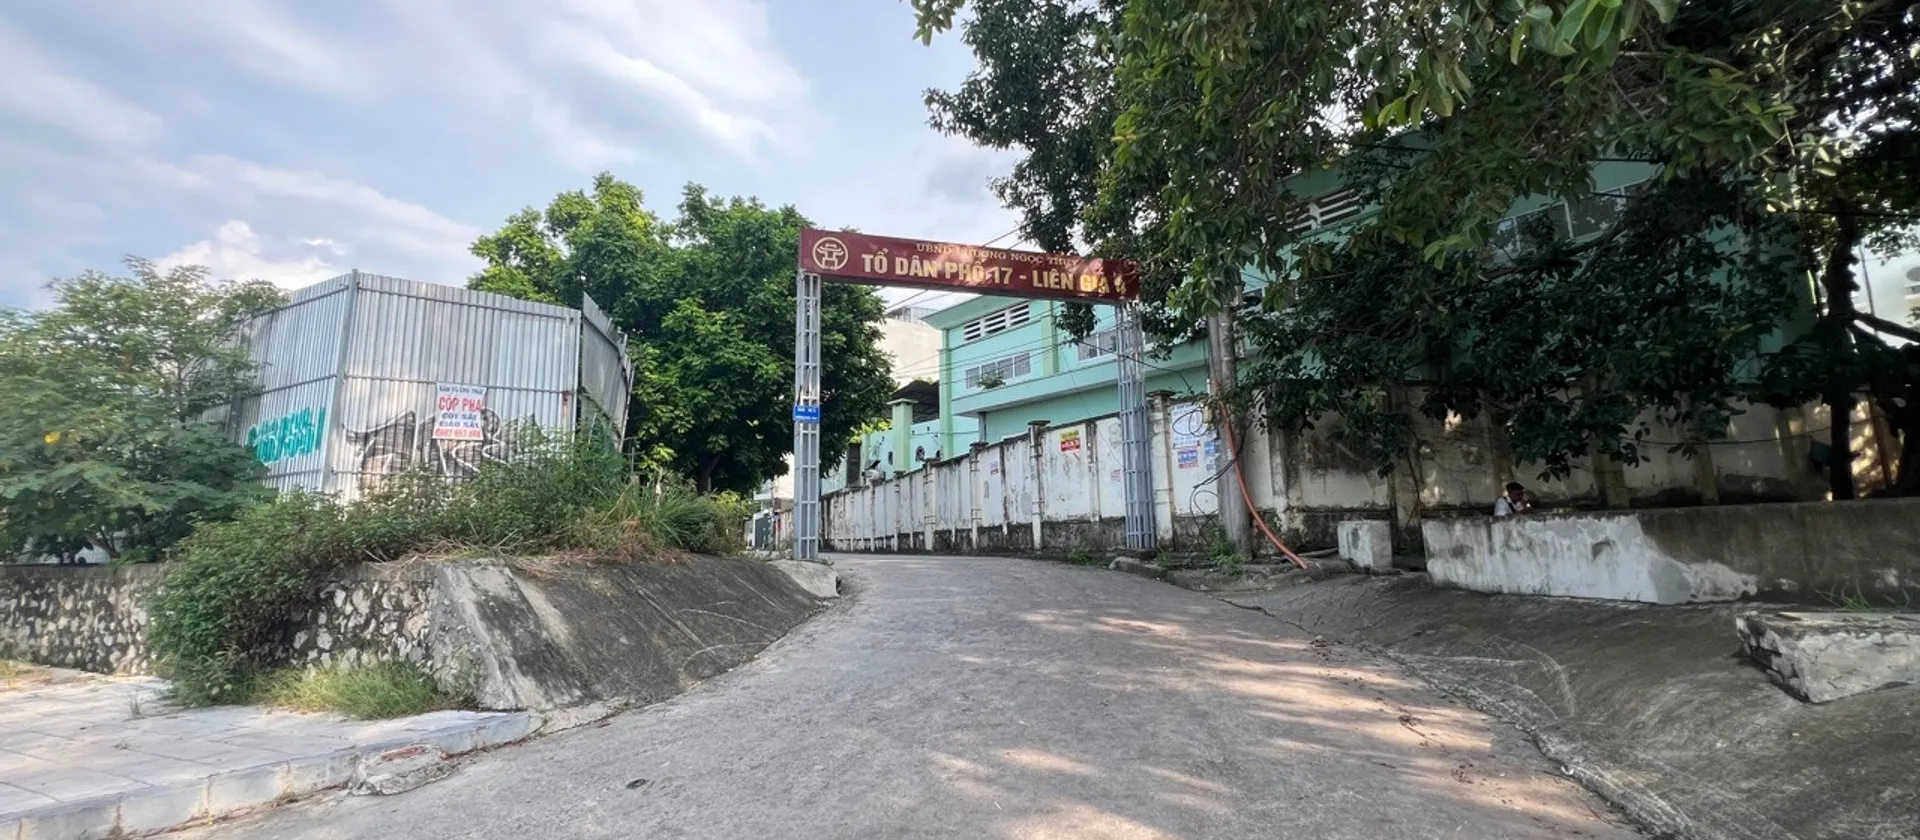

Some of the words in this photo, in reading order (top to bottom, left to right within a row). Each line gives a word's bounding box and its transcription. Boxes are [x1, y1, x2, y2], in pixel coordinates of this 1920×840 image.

[916, 243, 953, 256] UBND
[861, 248, 889, 274] TỔ
[895, 254, 938, 278] DÂN
[944, 258, 986, 282] PHỐ
[989, 265, 1013, 285] 17
[1032, 268, 1074, 290] LIÊN
